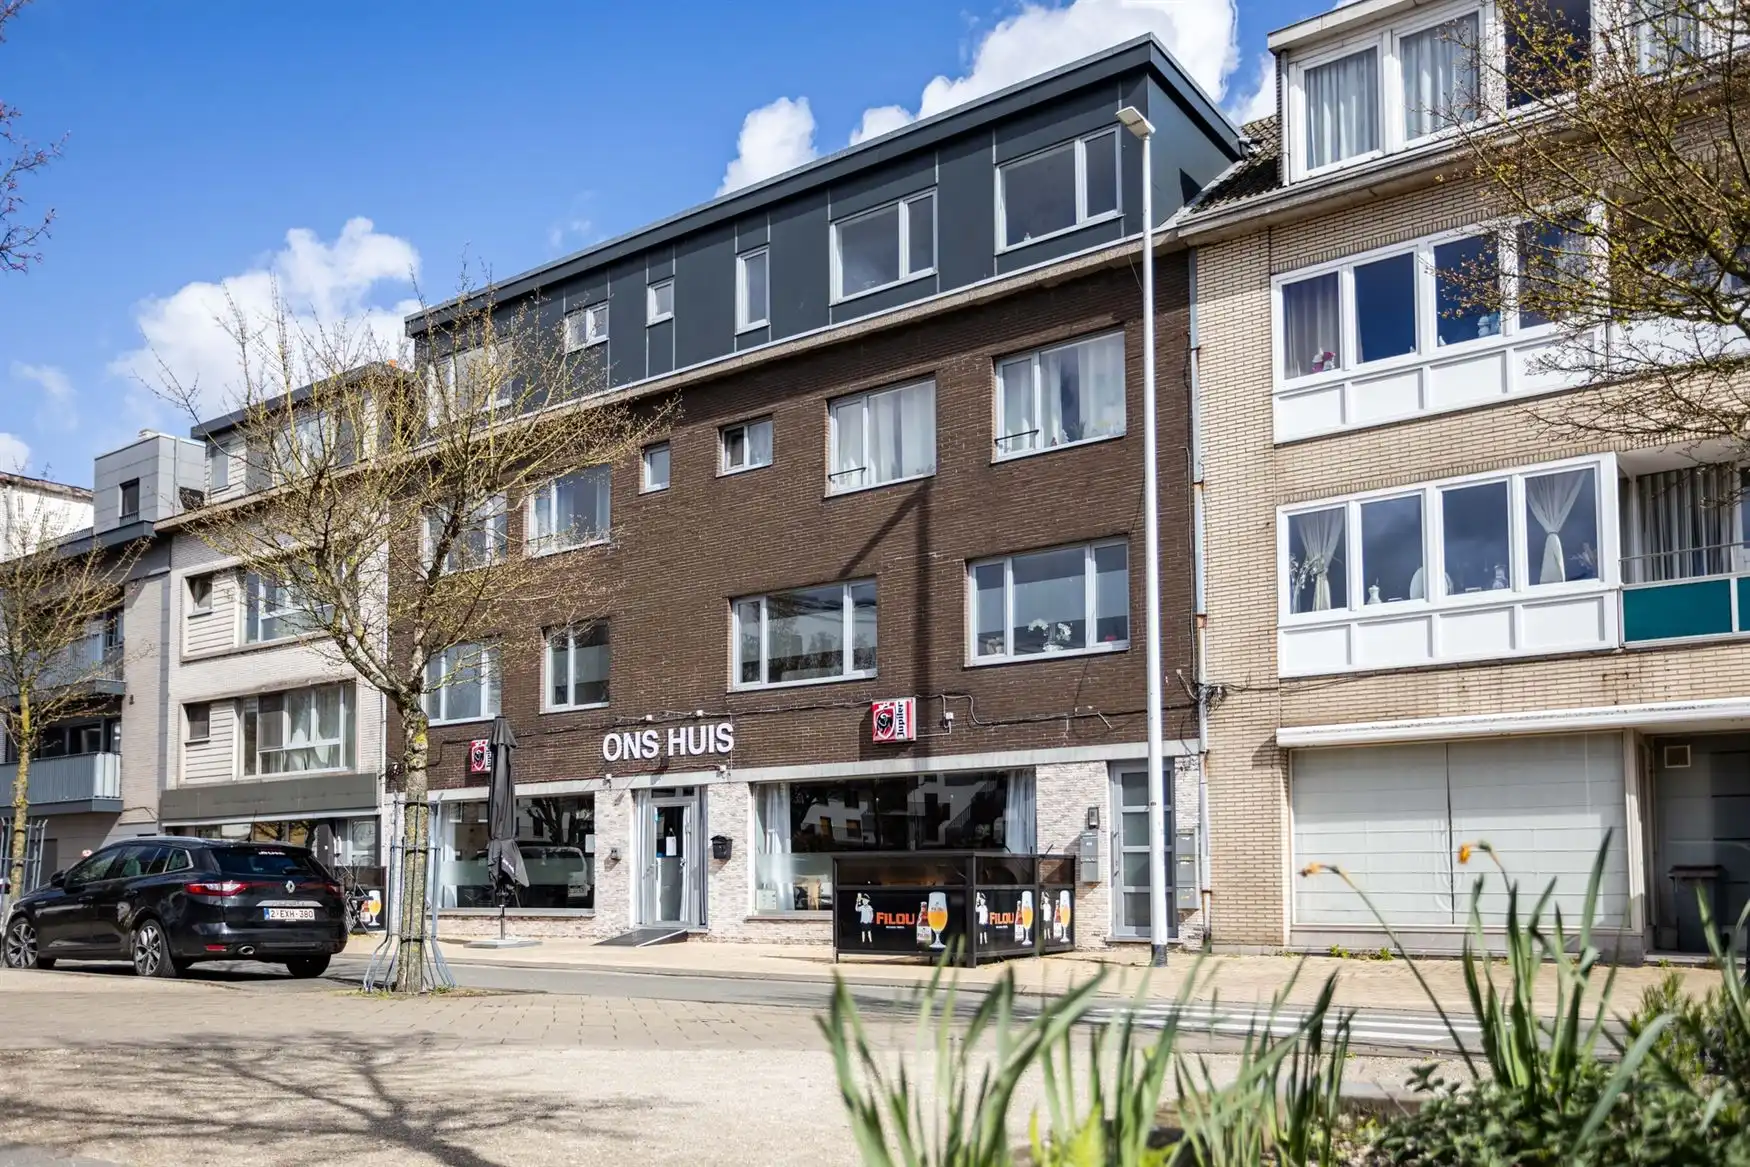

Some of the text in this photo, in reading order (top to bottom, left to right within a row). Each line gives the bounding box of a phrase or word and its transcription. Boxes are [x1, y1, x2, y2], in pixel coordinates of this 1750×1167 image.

[896, 701, 905, 738] Jupiler
[603, 723, 734, 761] ONS HUIS
[876, 911, 915, 925] FILOU
[989, 911, 1015, 925] FILOU
